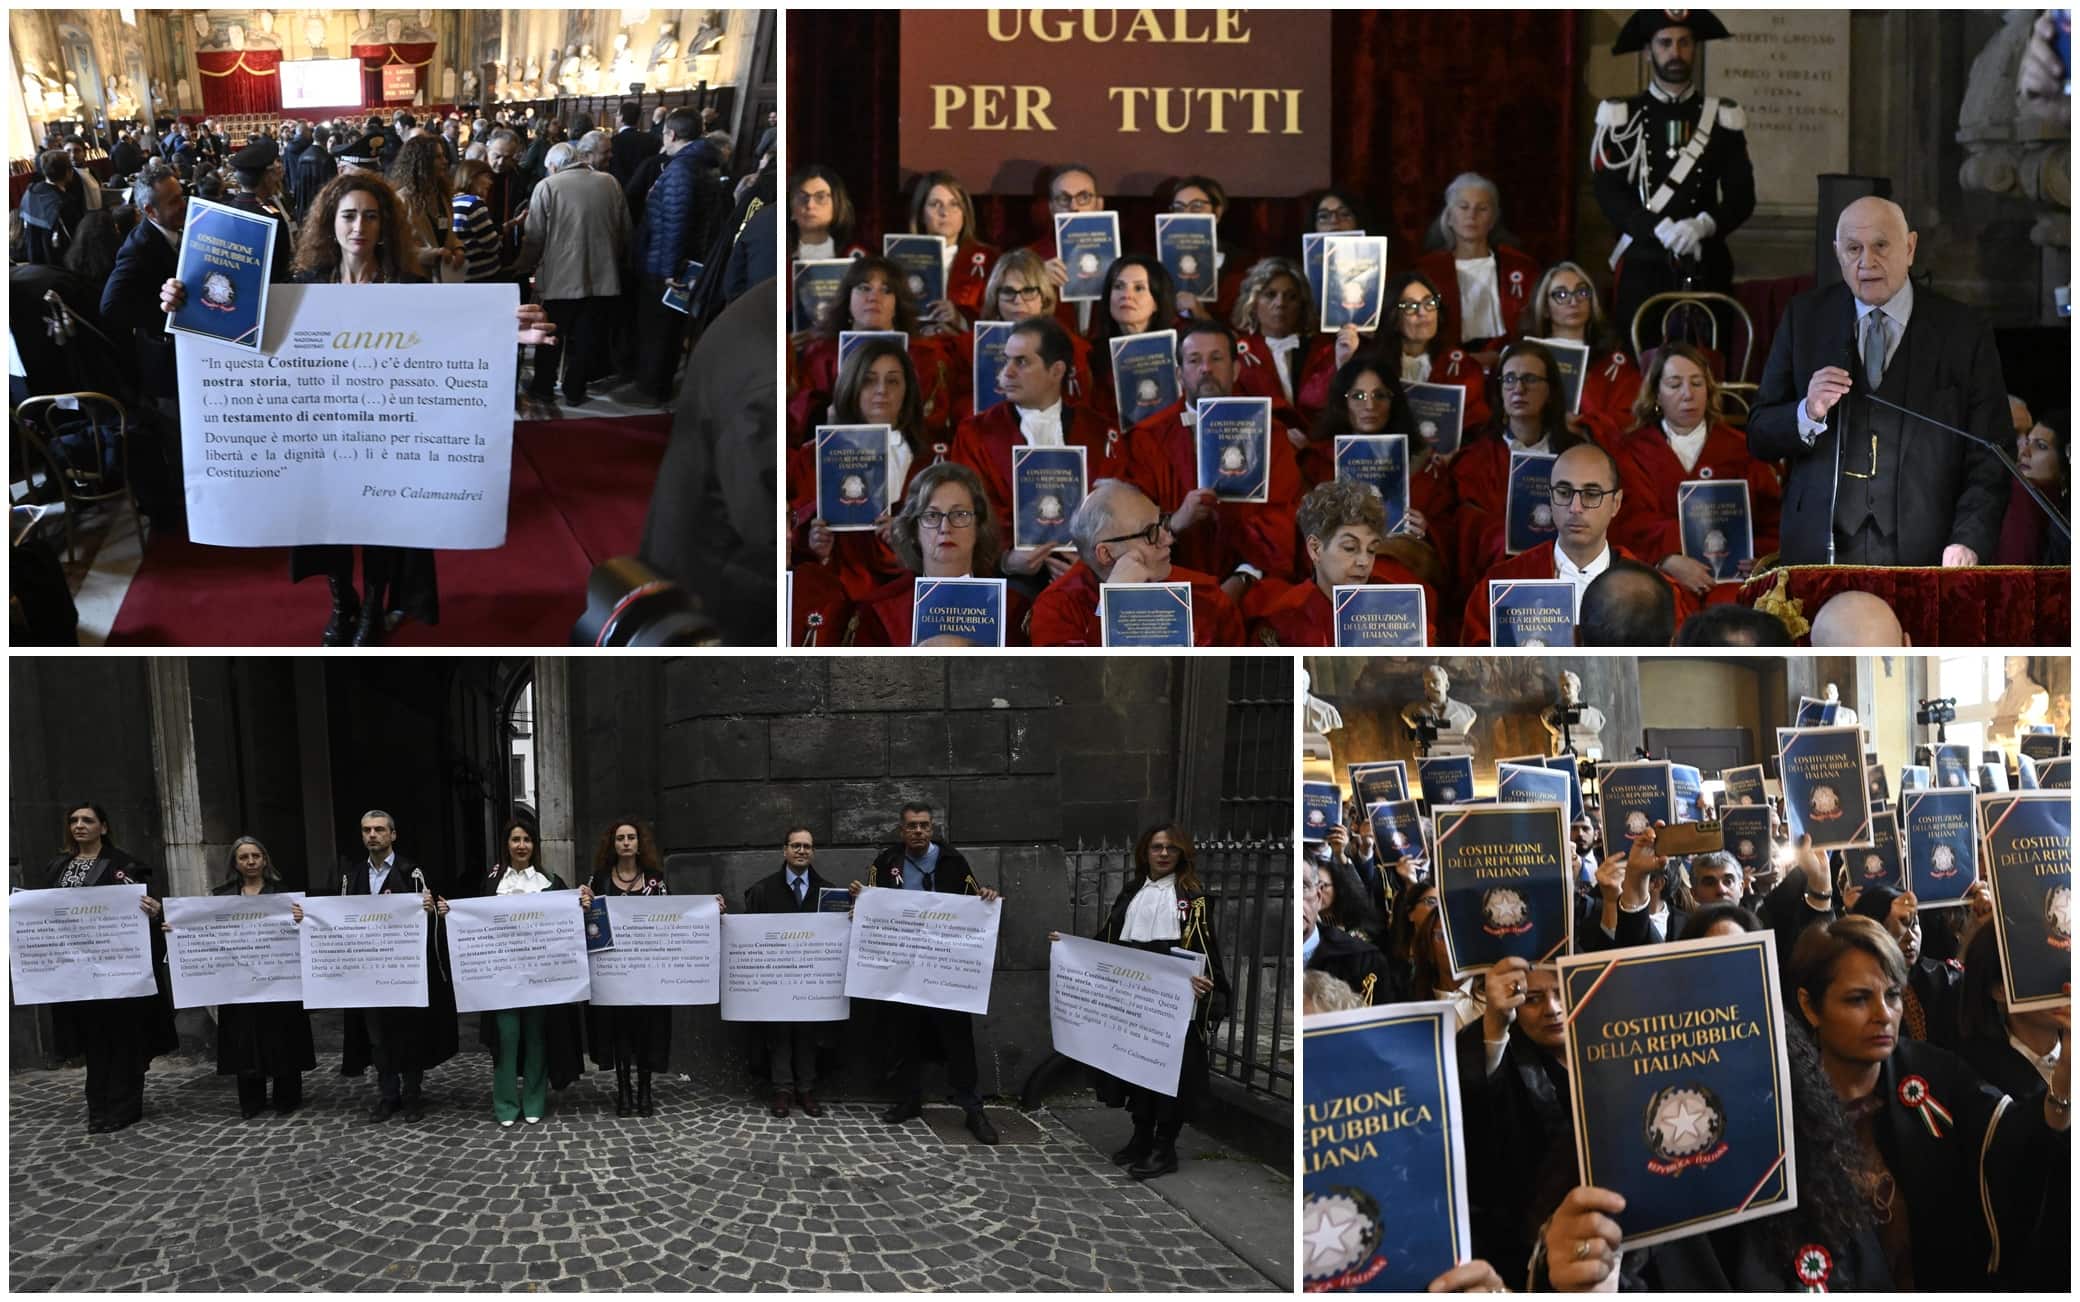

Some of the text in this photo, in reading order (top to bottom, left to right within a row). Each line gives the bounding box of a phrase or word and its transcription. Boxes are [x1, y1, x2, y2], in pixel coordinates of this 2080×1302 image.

[985, 9, 1251, 43] UGUALE
[930, 85, 1304, 135] PER TUTTI
[225, 359, 264, 372] questa
[268, 356, 349, 369] Costituzione
[403, 357, 443, 369] dentro
[446, 359, 474, 370] tutta
[478, 358, 489, 370] la
[202, 375, 488, 389] nostra storia, tutto il nostro passato. Questa
[231, 396, 254, 405] non
[257, 394, 264, 405] è
[267, 396, 288, 405] una
[291, 395, 320, 404] carta
[323, 395, 358, 404] morta
[389, 393, 396, 405] è
[400, 396, 414, 405] un
[417, 395, 487, 408] testamento,
[204, 411, 418, 423] un testamento di centomila morti.
[205, 431, 486, 446] Dovunque è morto un italiano per riscattare la
[205, 449, 243, 461] libertà
[250, 452, 258, 461] e
[266, 449, 276, 460] la
[284, 448, 325, 462] dignità
[396, 451, 421, 461] nata
[429, 450, 440, 461] la
[447, 453, 485, 463] nostra
[362, 485, 484, 502] Piero Calamandrei
[929, 607, 988, 616] COSTITUZIONE
[1350, 613, 1408, 622] COSTITUZIONE
[1506, 607, 1562, 616] COSTITUZIONE
[921, 615, 994, 625] DELLA REPUBBLICA
[1369, 622, 1417, 631] REPUBBLICA
[1522, 615, 1570, 624] REPUBBLICA
[939, 624, 977, 632] ITALIANA
[1362, 630, 1399, 639] ITALIANA
[1517, 624, 1553, 632] ITALIANA
[1458, 842, 1543, 857] COSTITUZIONE
[1448, 854, 1556, 868] DELLA REPUBBLICA
[2001, 851, 2041, 867] DELLA
[1476, 867, 1530, 879] ITALIANA
[1602, 1004, 1740, 1039] COSTITUZIONE
[1587, 1021, 1761, 1062] DELLA REPUBBLICA
[1633, 1047, 1720, 1076] ITALIANA
